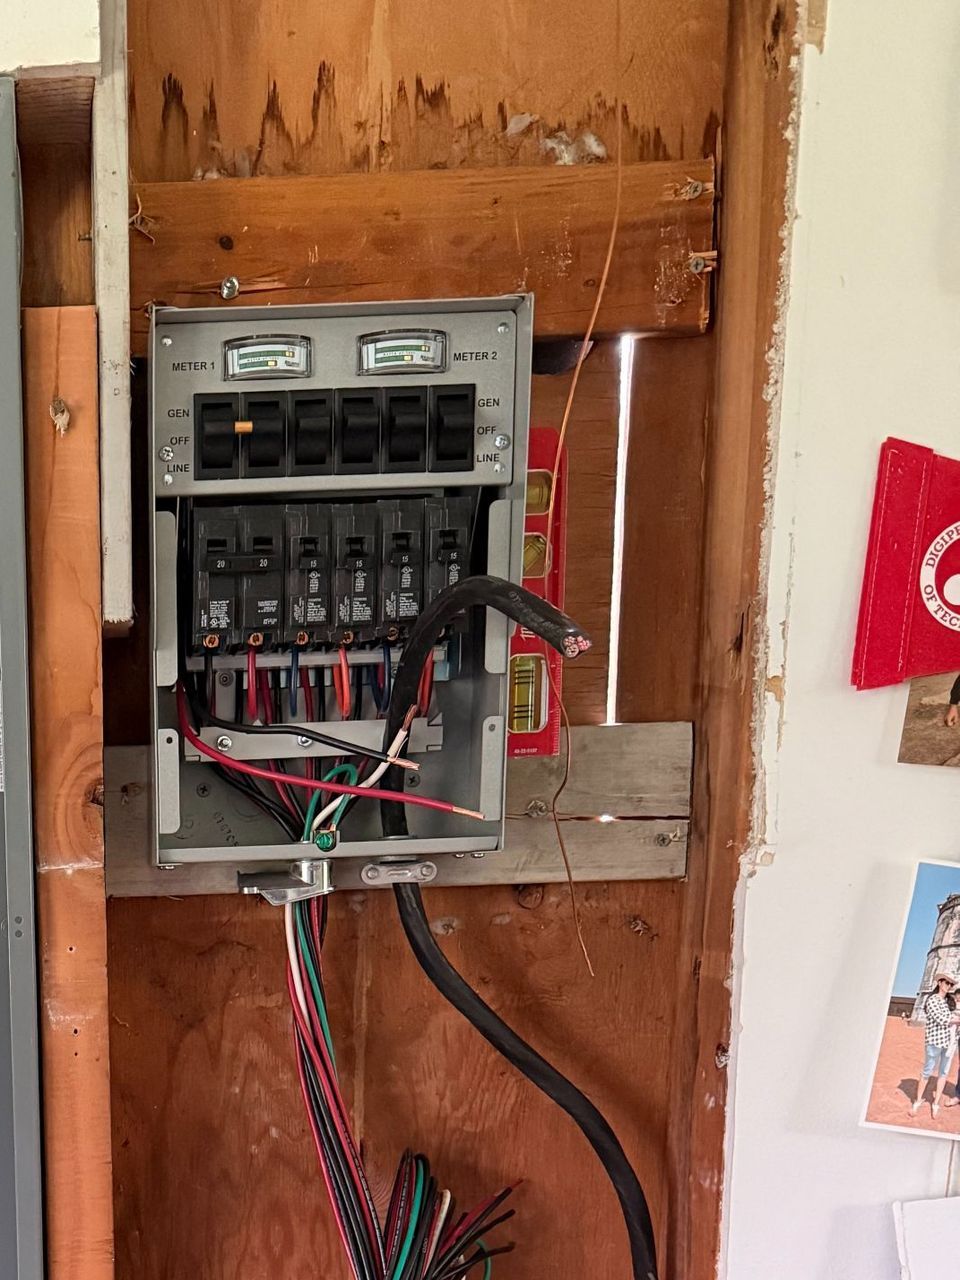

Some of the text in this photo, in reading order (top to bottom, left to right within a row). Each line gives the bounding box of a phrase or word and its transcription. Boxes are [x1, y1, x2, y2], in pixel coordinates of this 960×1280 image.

[453, 351, 498, 361] METER 2
[172, 361, 215, 371] METER 1
[477, 398, 500, 407] GEN
[167, 409, 190, 418] GEN
[476, 426, 497, 435] OFF
[170, 437, 190, 445] OFF
[476, 454, 500, 462] LINE
[167, 464, 190, 473] LINE
[402, 555, 409, 563] 15
[450, 552, 457, 560] 15
[217, 560, 225, 568] 20
[260, 559, 268, 567] 20
[310, 560, 317, 568] 15
[356, 560, 363, 568] 15
[923, 584, 960, 628] OF TEC
